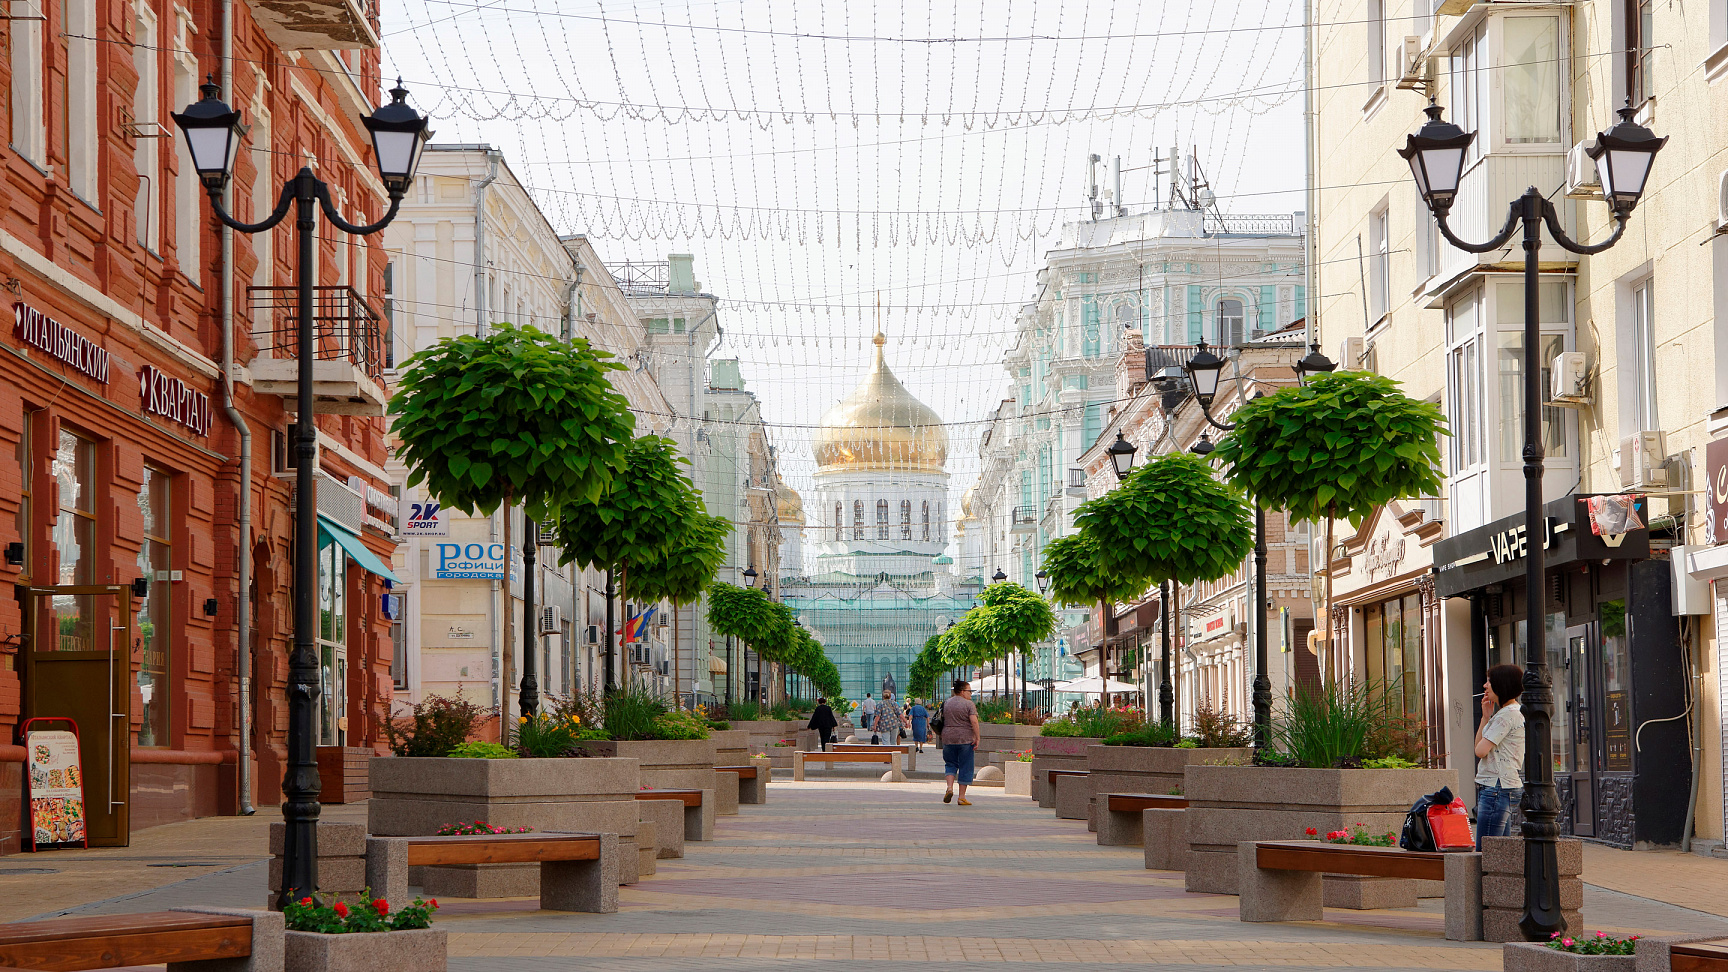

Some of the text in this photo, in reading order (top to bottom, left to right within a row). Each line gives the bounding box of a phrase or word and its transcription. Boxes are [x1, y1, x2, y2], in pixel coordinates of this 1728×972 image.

[148, 365, 209, 438] КВАРТАЛ
[409, 503, 441, 521] 2K
[407, 521, 439, 529] SPORT
